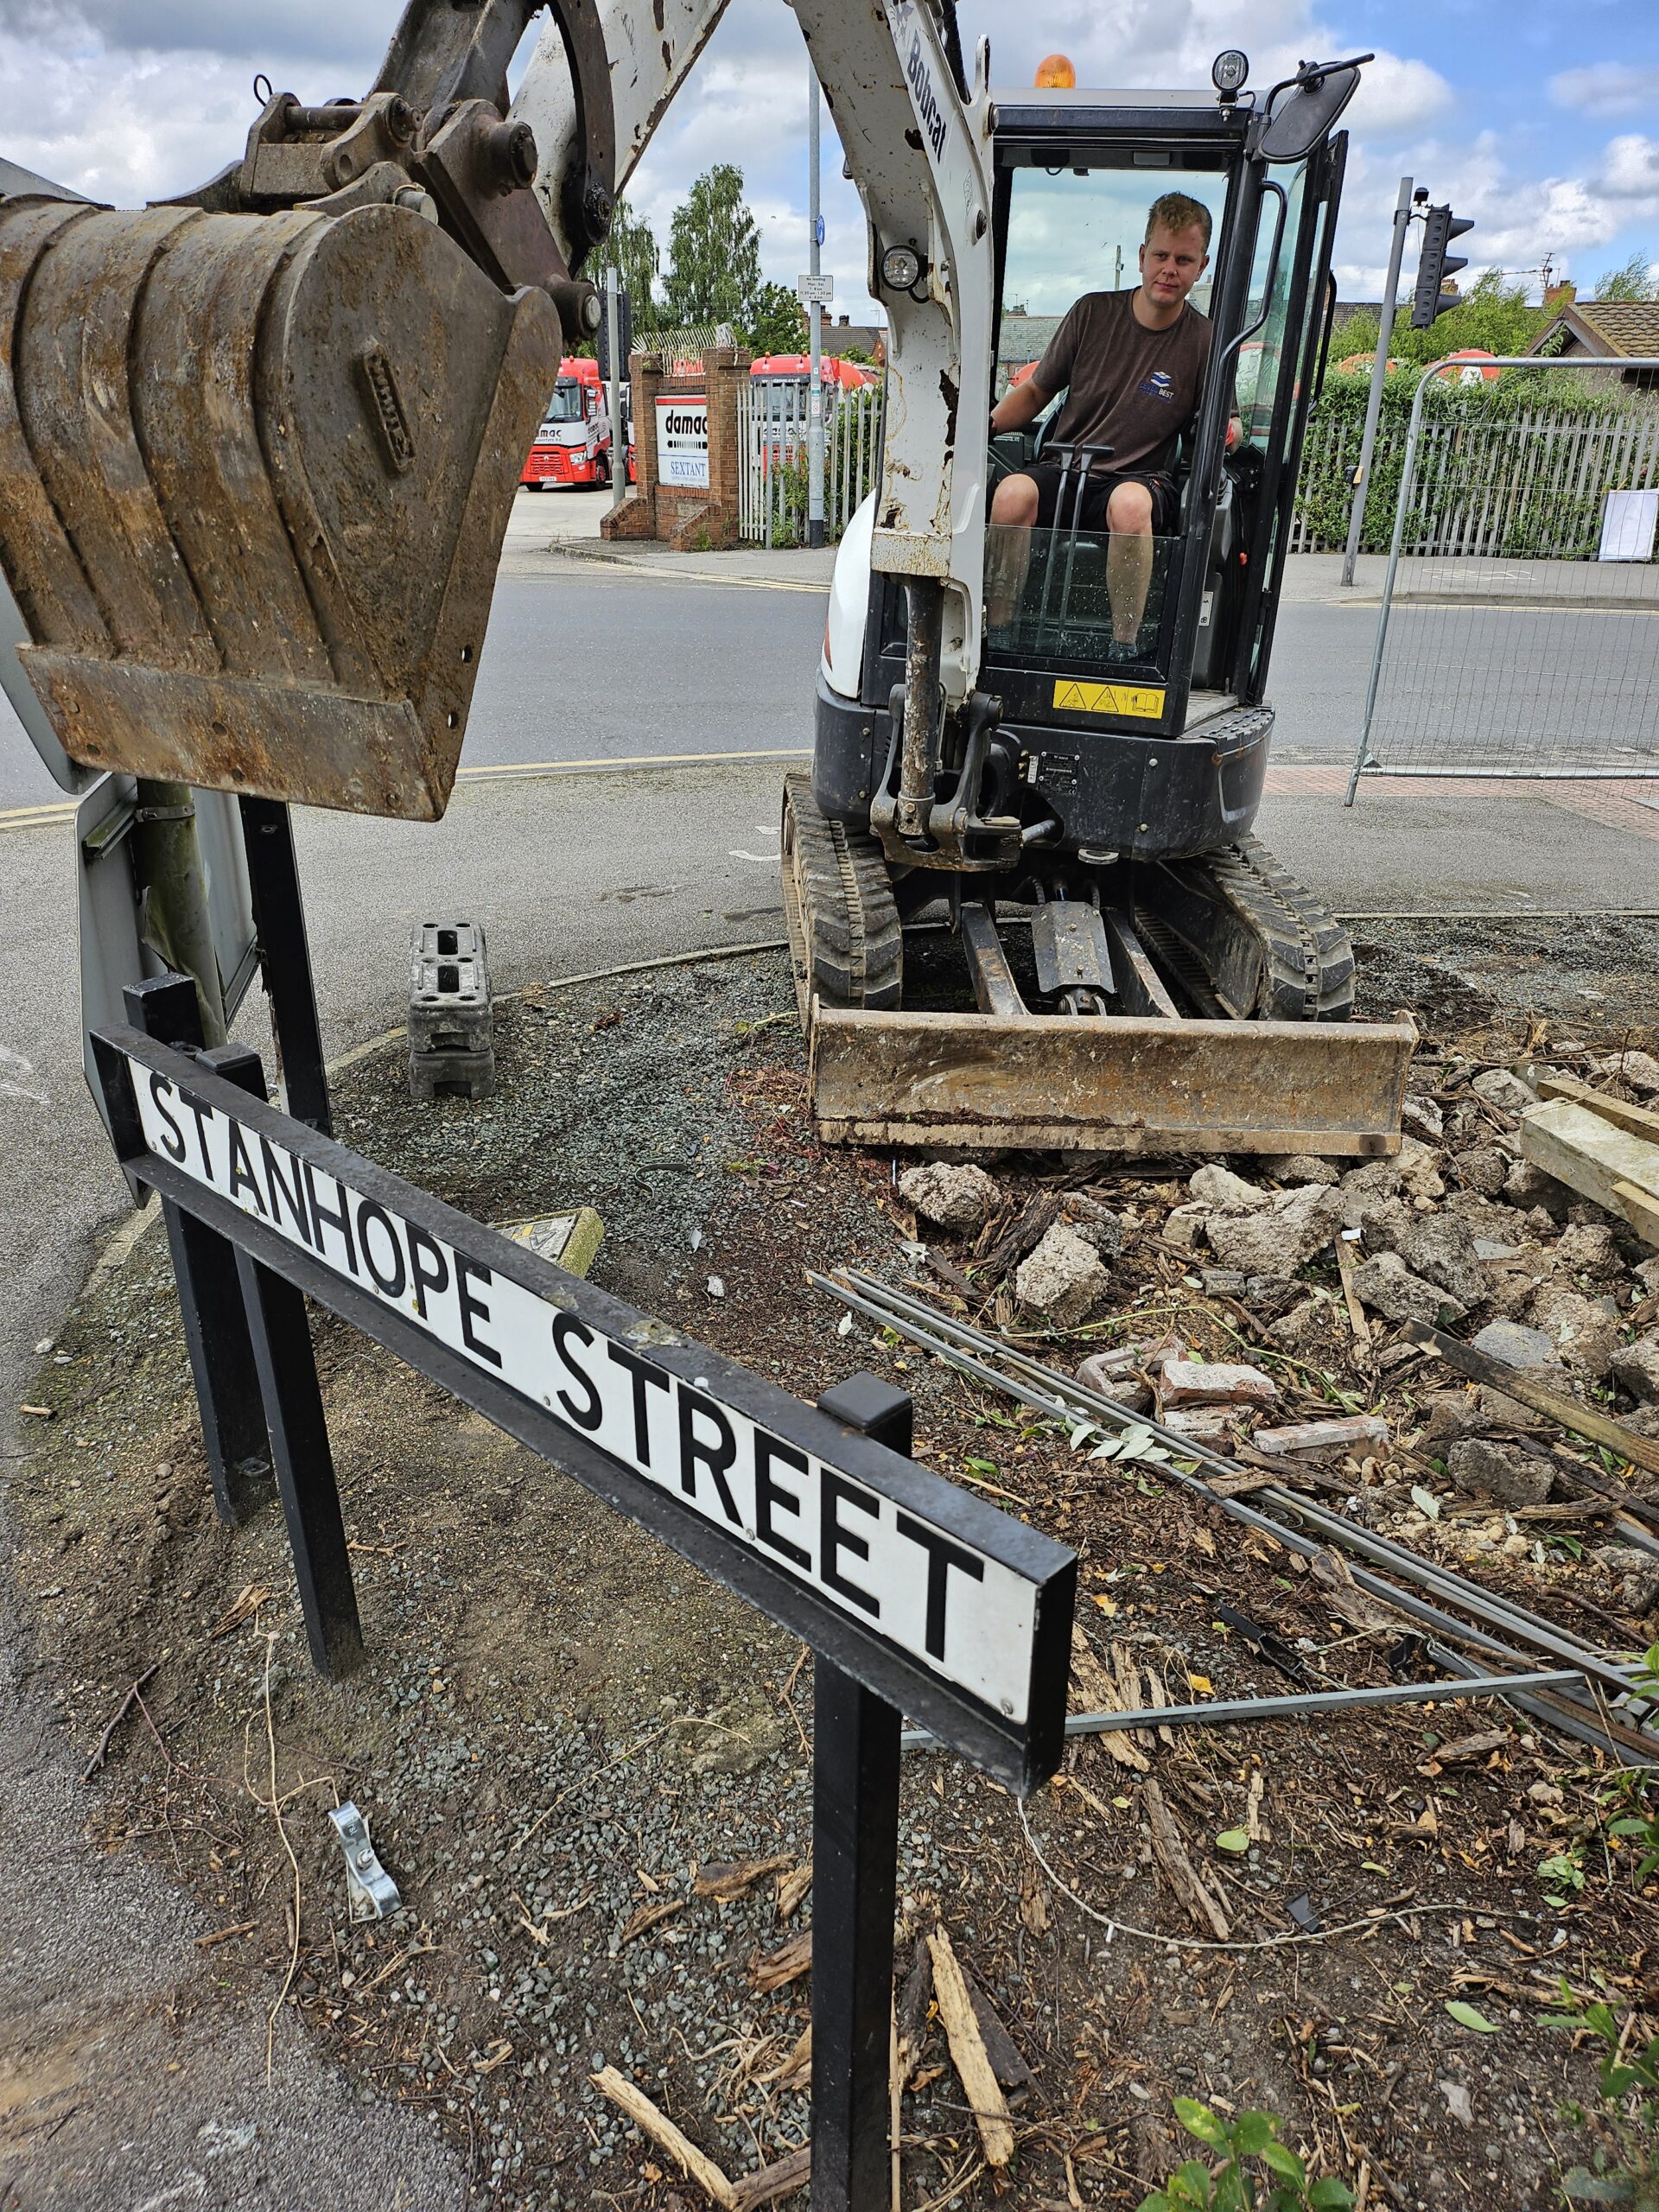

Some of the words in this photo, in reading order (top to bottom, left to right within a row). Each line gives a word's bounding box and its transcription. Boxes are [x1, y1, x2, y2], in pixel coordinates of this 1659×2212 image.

[907, 29, 947, 165] Bobcat
[1158, 388, 1175, 399] BEST
[665, 409, 708, 435] damac
[671, 461, 706, 477] SEXTANT
[149, 1071, 503, 1369] STANHOPE
[551, 1312, 985, 1662] STREET
